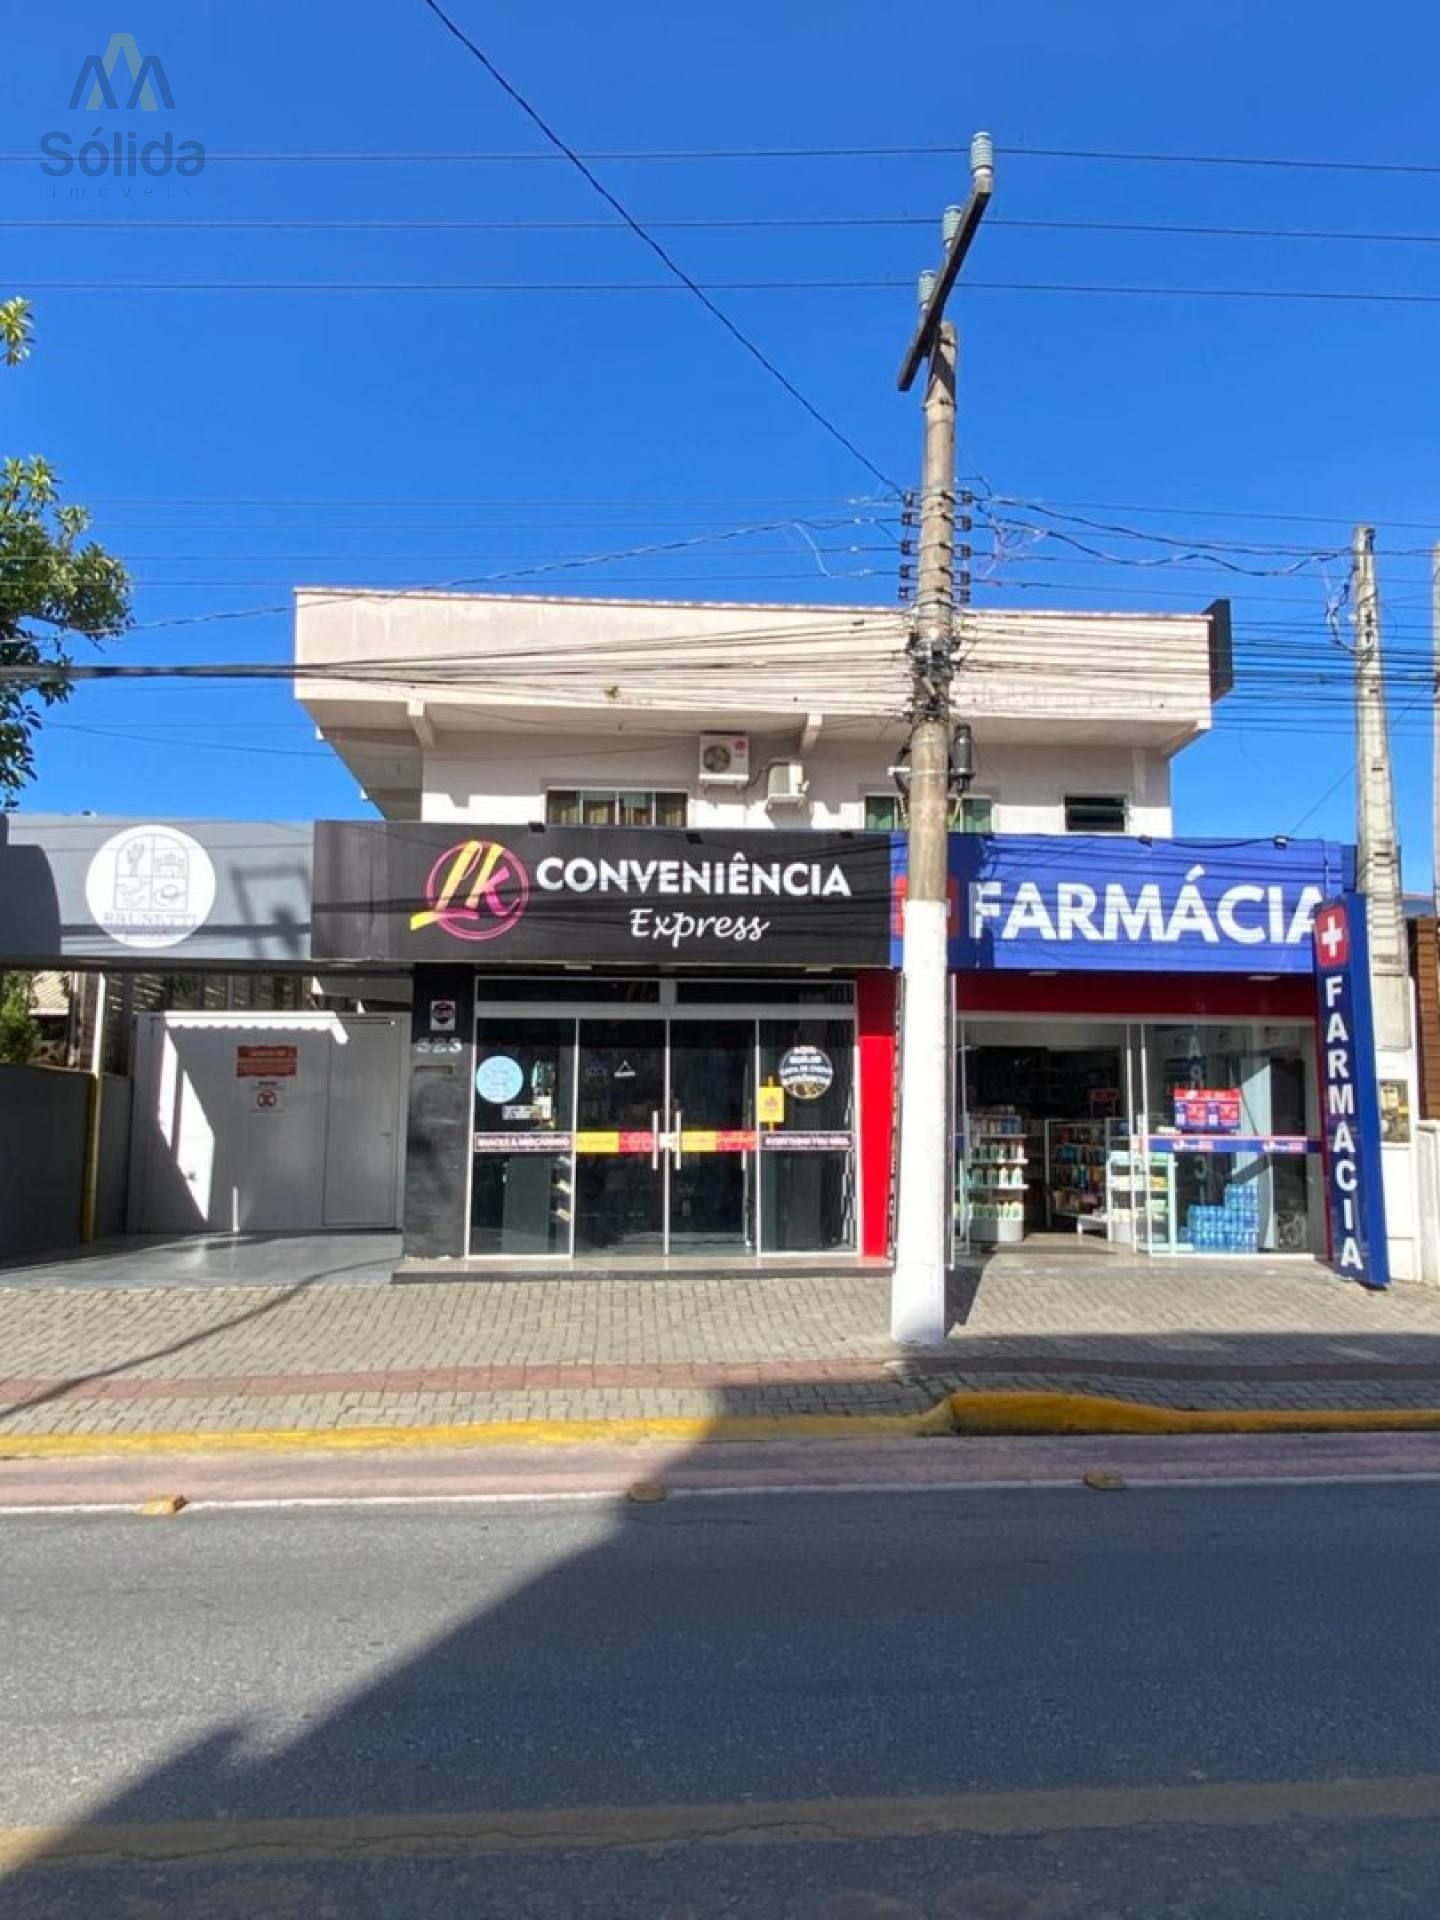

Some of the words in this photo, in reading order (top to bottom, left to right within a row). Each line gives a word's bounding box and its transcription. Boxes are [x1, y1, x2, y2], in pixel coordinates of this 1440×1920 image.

[535, 851, 852, 897] CONVENIÊNCIA
[968, 864, 1324, 944] FARMÁCIA
[629, 908, 771, 948] Express
[1325, 975, 1364, 1271] FARMACIA
